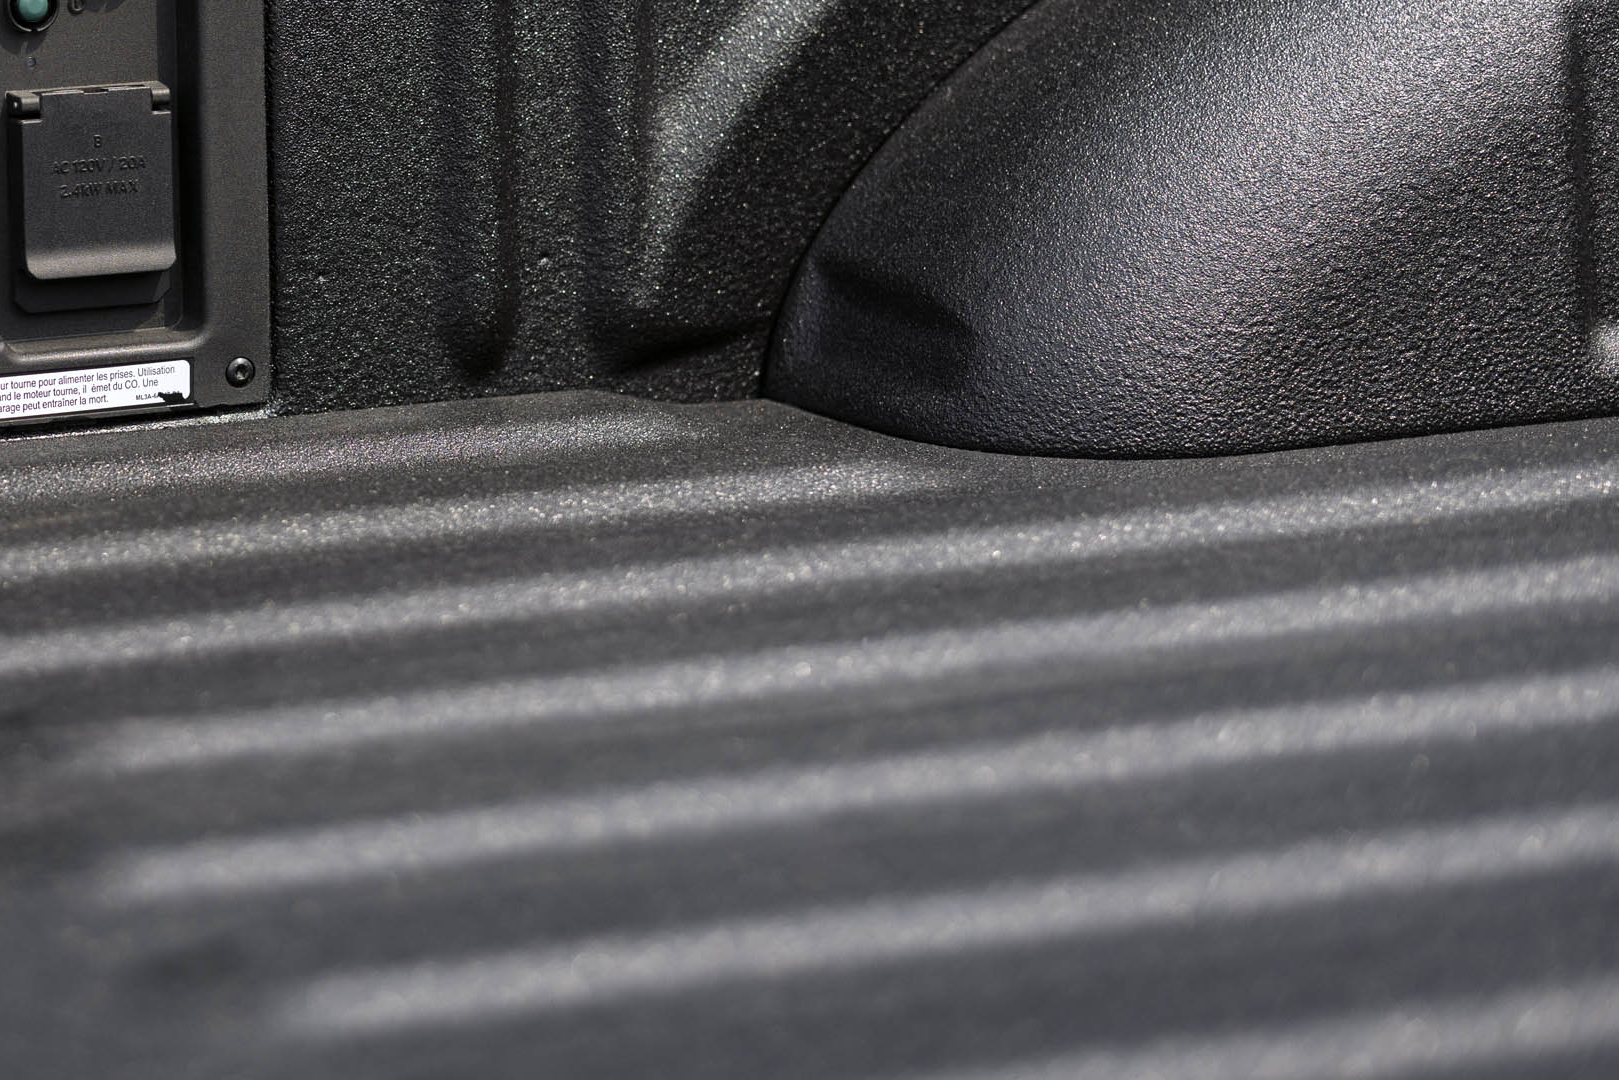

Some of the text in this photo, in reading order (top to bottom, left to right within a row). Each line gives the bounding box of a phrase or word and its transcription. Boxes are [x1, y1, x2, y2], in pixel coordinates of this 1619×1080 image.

[93, 134, 102, 148] B
[52, 161, 70, 174] AC
[72, 158, 106, 173] 120V
[118, 155, 146, 170] 20A
[106, 179, 139, 195] MAX
[11, 379, 36, 389] tourne
[38, 377, 56, 388] pour
[58, 374, 94, 385] alimenter
[96, 372, 108, 381] les
[110, 369, 135, 382] prises.
[138, 366, 175, 377] Utilisation
[14, 391, 21, 400] le
[23, 388, 50, 399] moteur
[53, 386, 81, 397] tourne,
[82, 384, 87, 393] il
[91, 382, 111, 392] émet
[112, 380, 123, 390] du
[125, 379, 141, 389] CO.
[142, 378, 159, 388] Une
[22, 402, 40, 413] peut
[42, 397, 78, 409] entraîner
[79, 395, 87, 405] la
[89, 394, 109, 404] mort.
